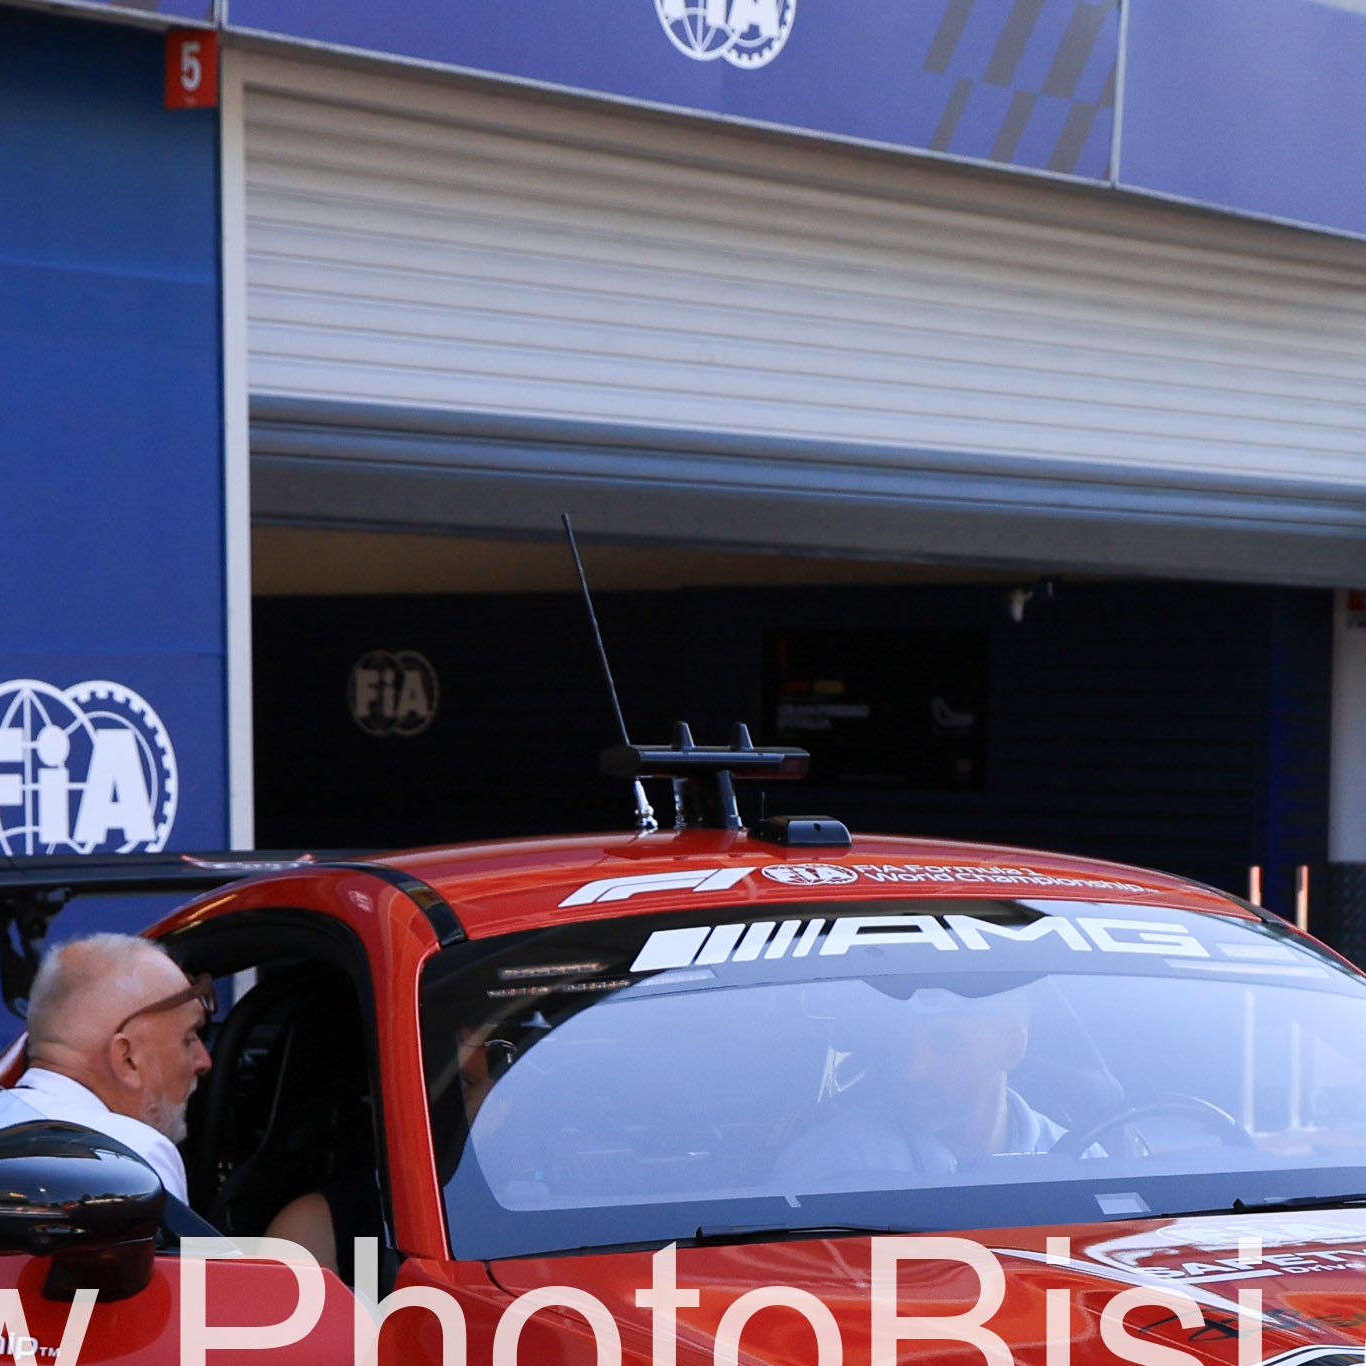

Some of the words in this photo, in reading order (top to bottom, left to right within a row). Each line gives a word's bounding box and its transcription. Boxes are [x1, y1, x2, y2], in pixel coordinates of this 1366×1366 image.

[180, 40, 202, 91] 5
[851, 864, 902, 874] FIA
[903, 865, 1022, 876] Formula
[864, 872, 956, 883] World
[558, 866, 756, 908] F1
